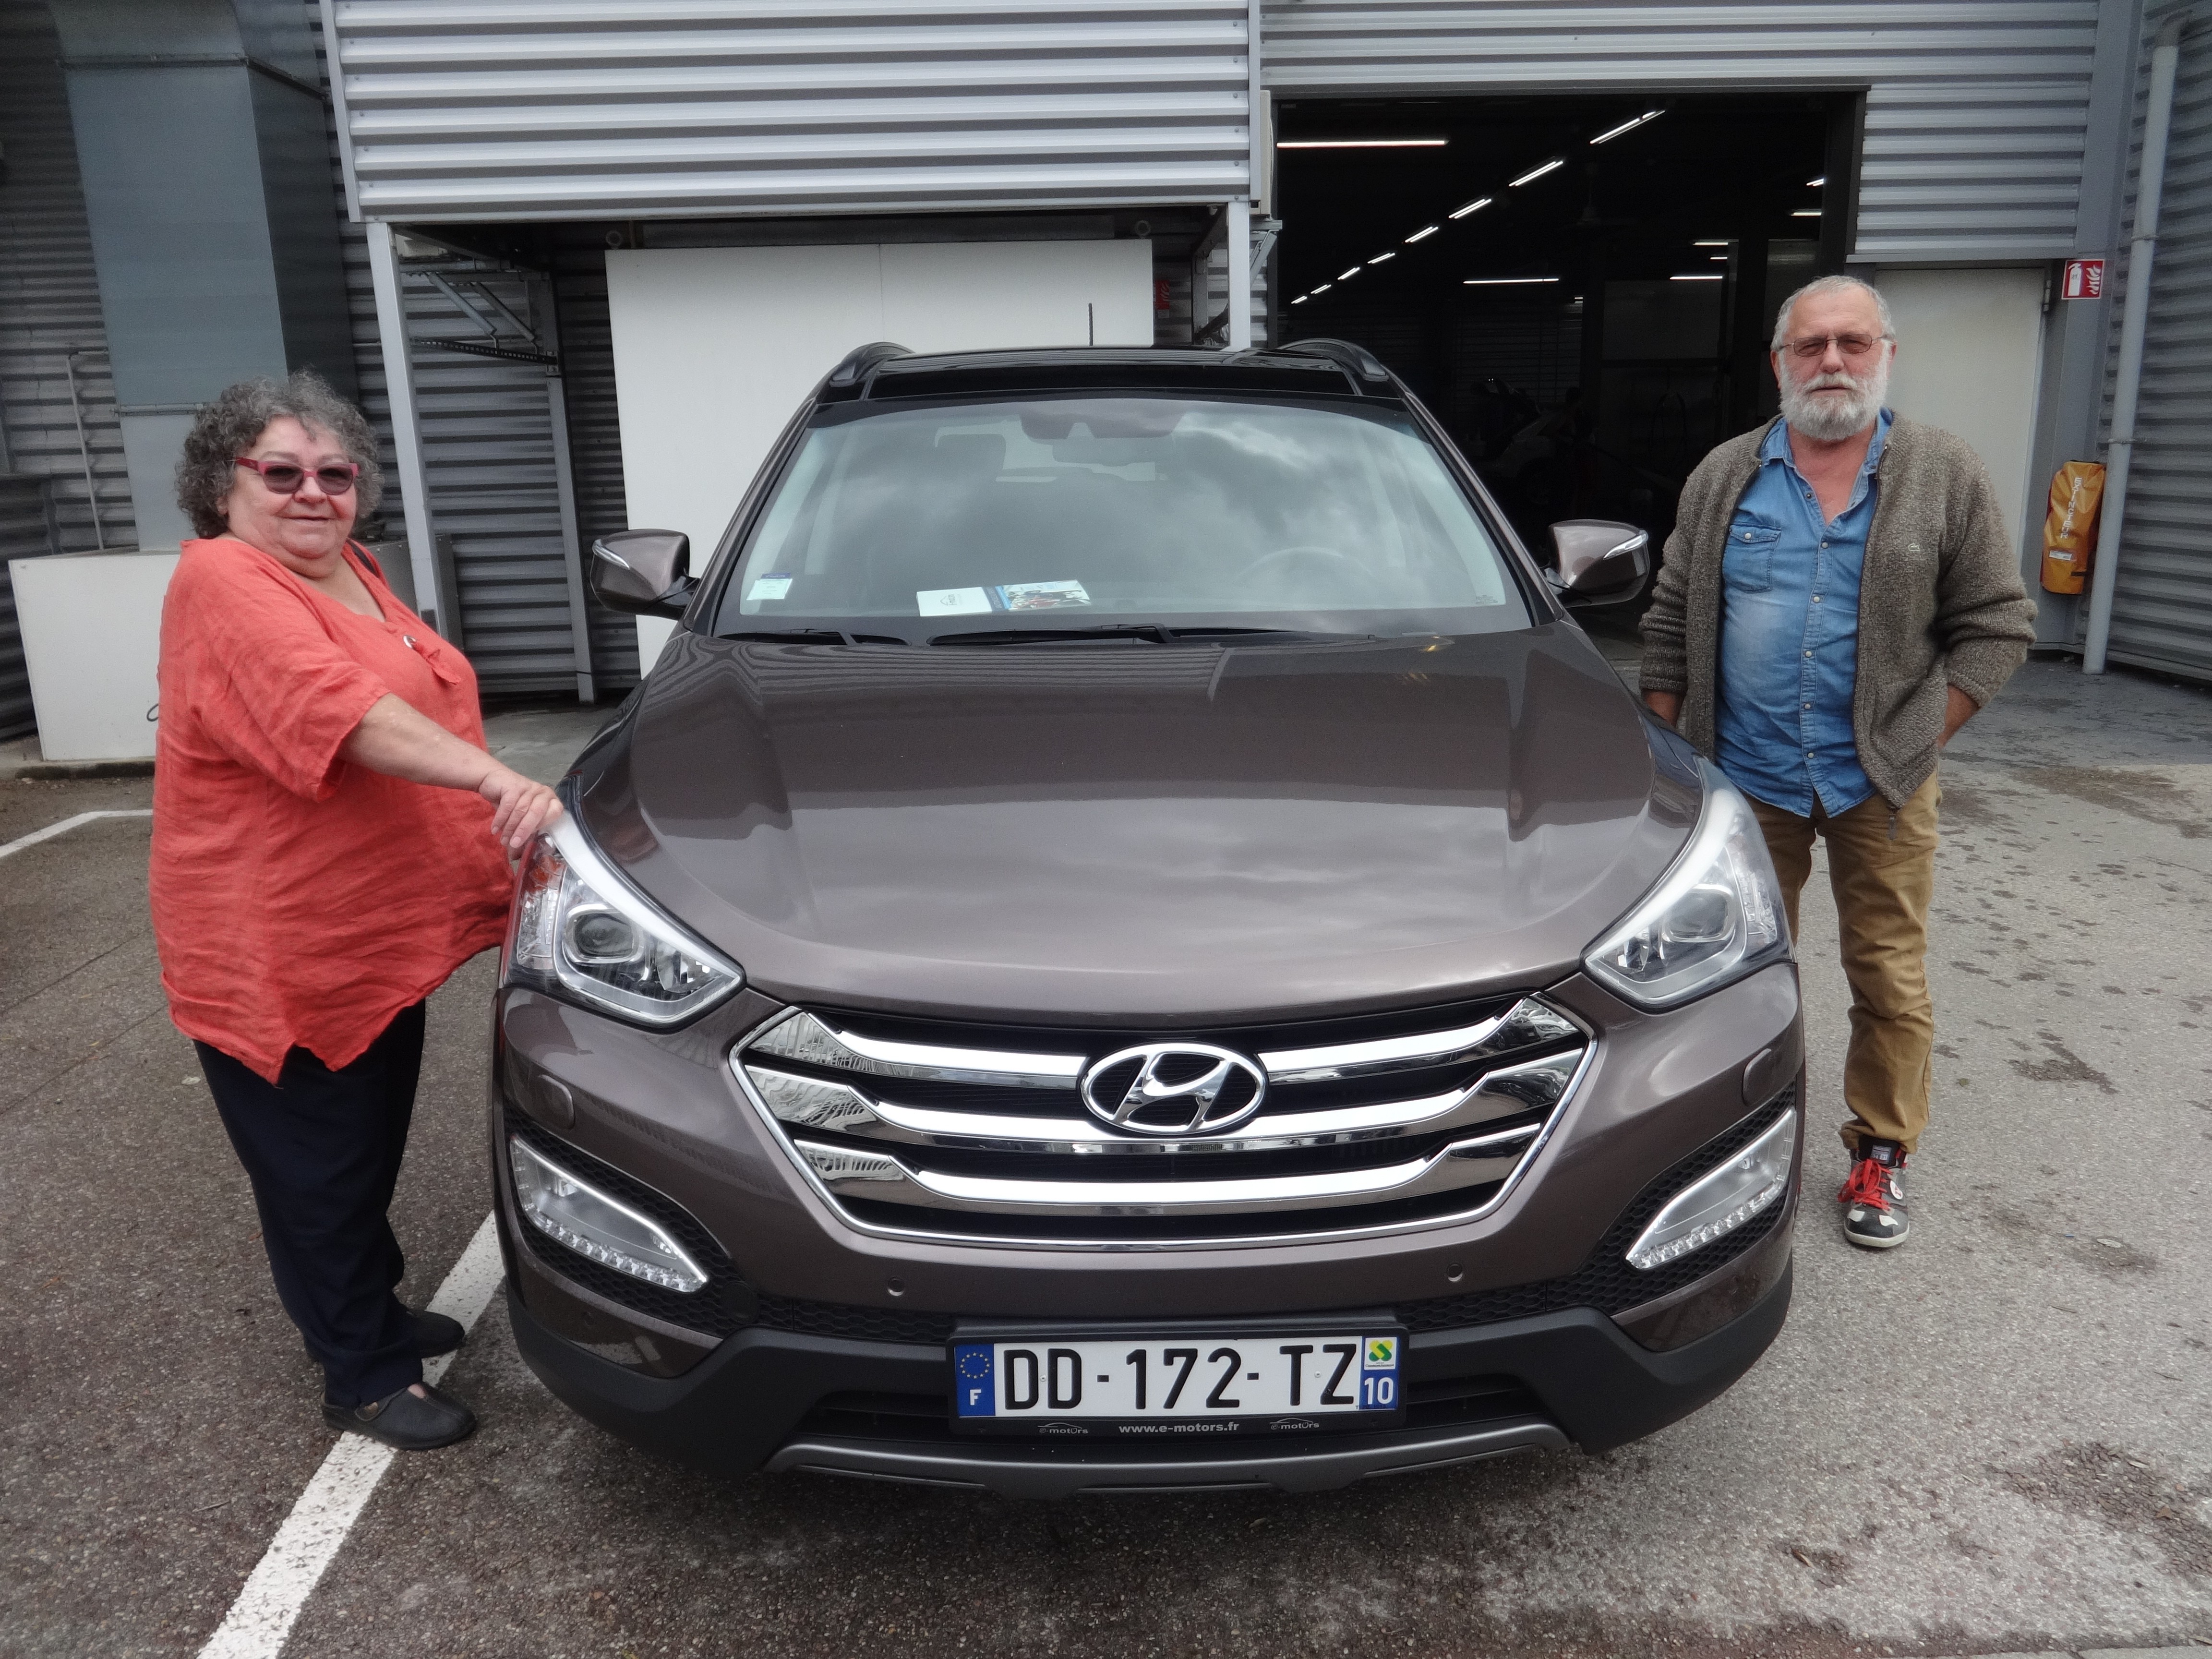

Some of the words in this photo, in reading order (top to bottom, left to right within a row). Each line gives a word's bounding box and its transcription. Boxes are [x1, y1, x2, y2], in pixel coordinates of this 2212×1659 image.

[2060, 477, 2082, 539] EXTINCTEUR
[970, 1389, 982, 1406] F
[1364, 1376, 1394, 1405] 10
[1118, 1421, 1239, 1433] www.e-motors.fr
